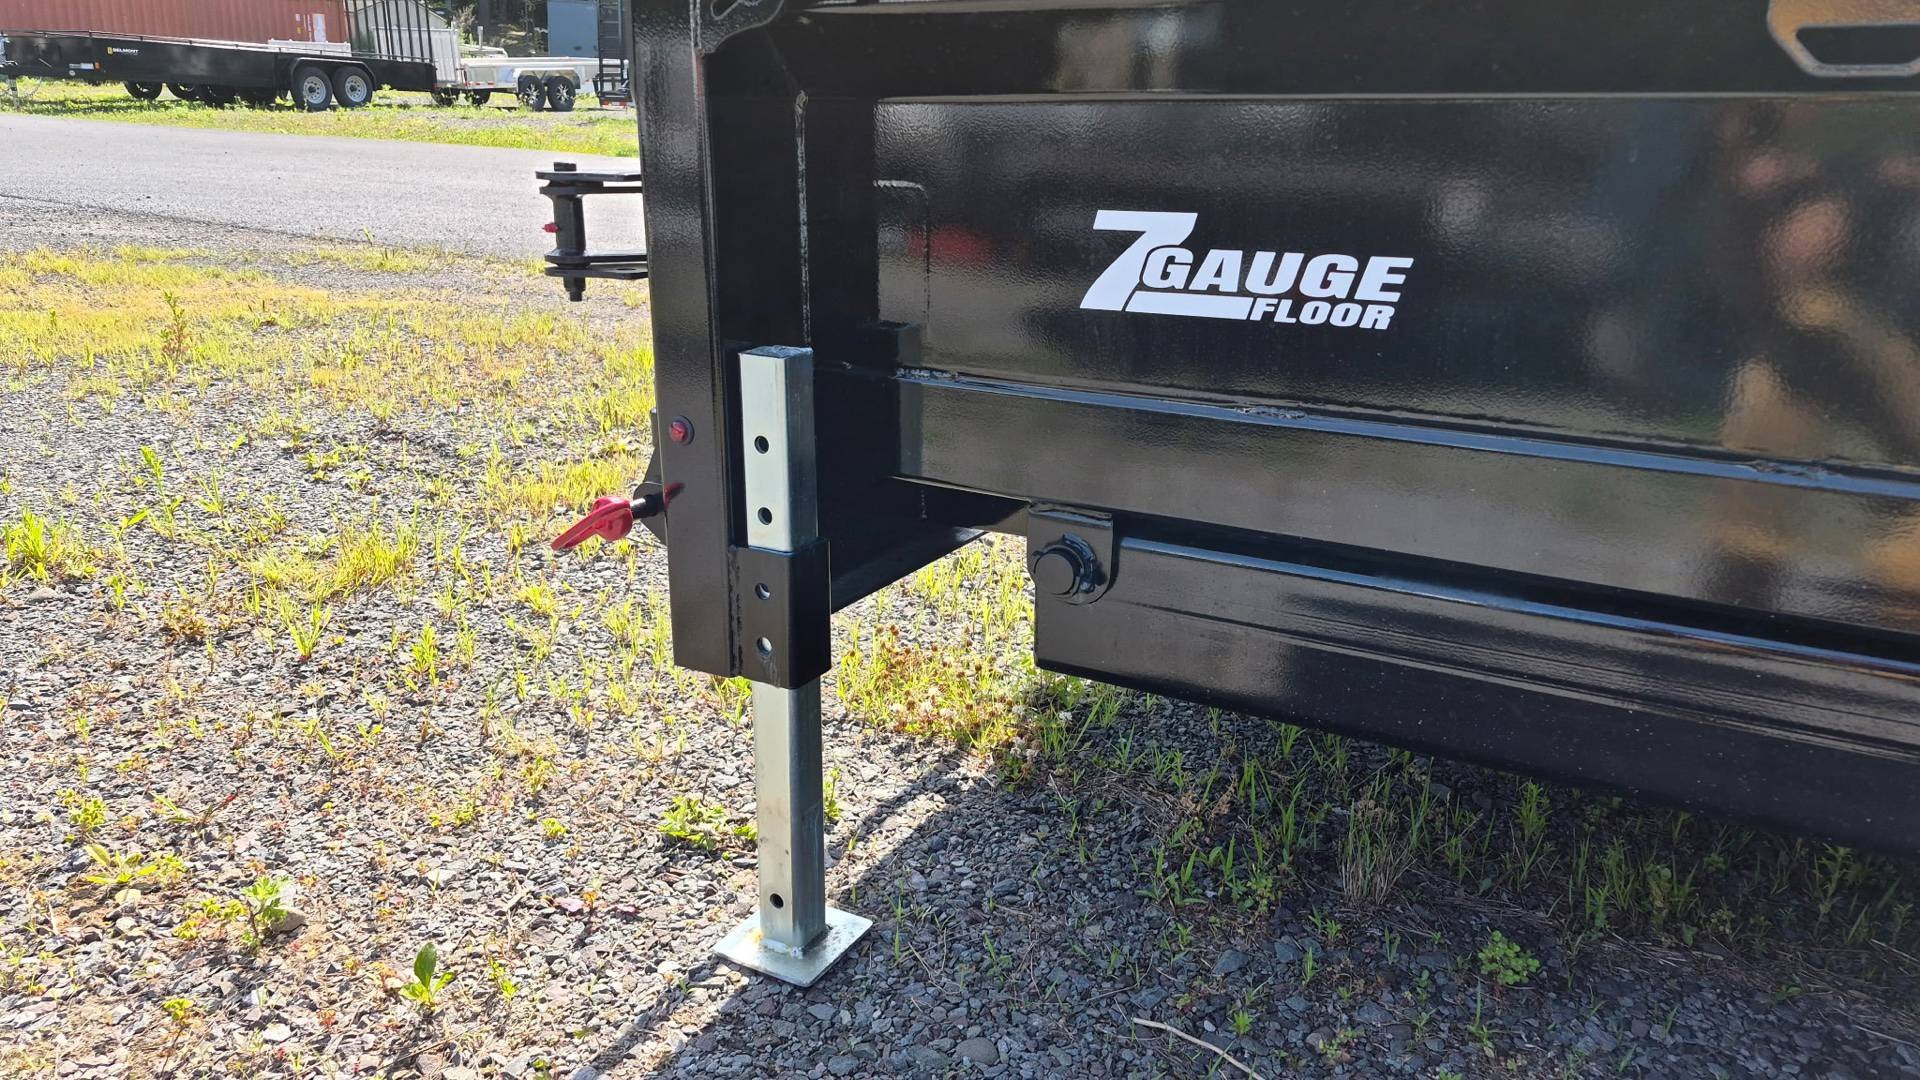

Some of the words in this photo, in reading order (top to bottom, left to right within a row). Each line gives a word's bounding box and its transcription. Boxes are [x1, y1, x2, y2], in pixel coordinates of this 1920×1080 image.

[1080, 210, 1198, 311] 7
[1142, 247, 1414, 302] GAUGE
[1250, 298, 1395, 330] FLOOR
